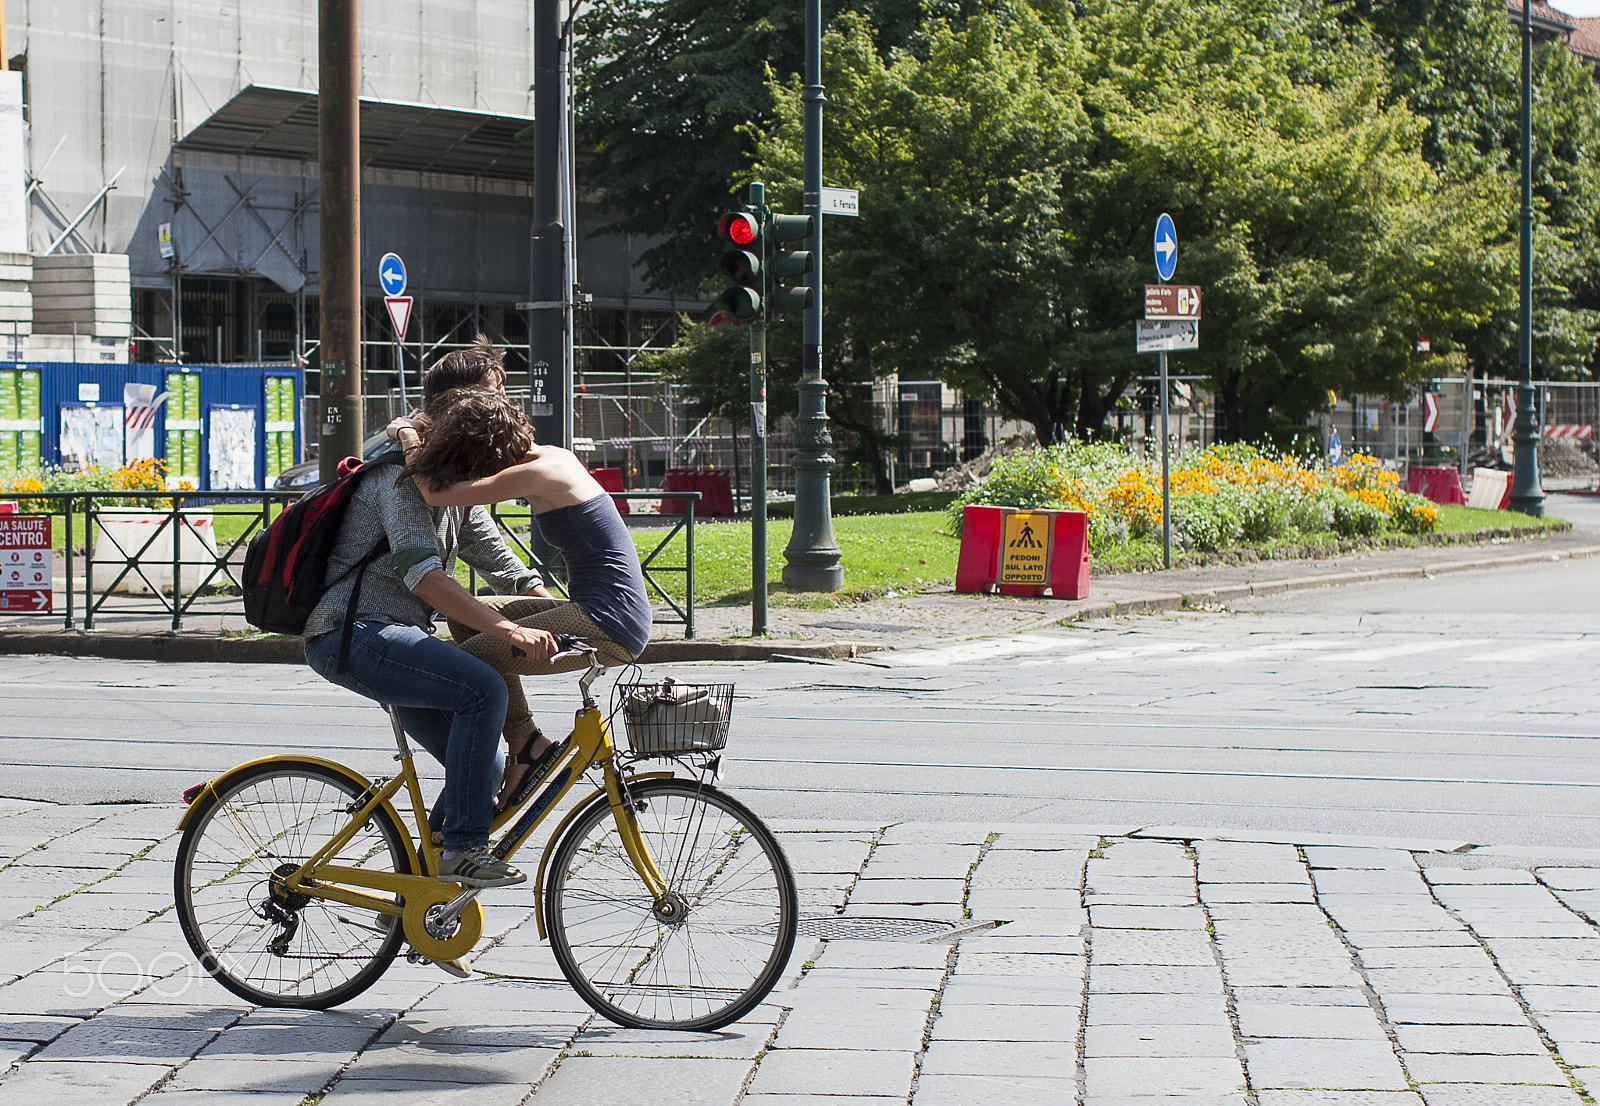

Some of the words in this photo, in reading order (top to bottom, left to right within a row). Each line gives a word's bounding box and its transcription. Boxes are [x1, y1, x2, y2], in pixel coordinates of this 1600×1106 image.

[536, 387, 542, 395] 2
[11, 520, 47, 532] SALUTE,
[0, 531, 48, 546] CENTRO.
[1010, 554, 1041, 562] PEDONI
